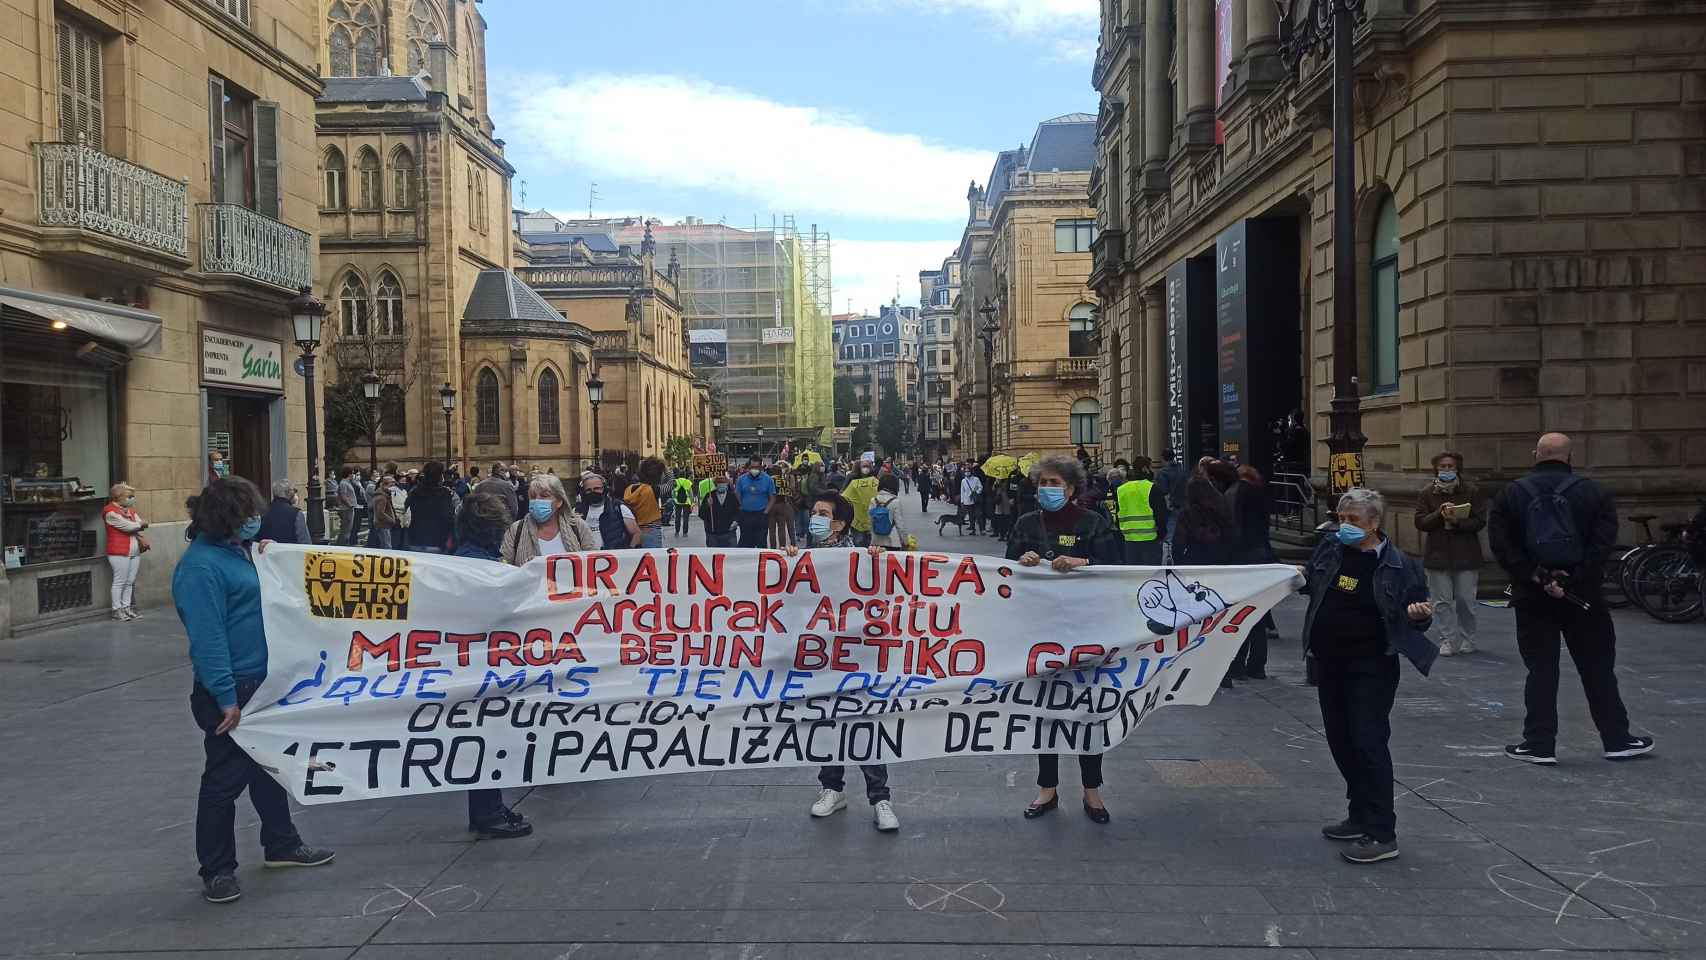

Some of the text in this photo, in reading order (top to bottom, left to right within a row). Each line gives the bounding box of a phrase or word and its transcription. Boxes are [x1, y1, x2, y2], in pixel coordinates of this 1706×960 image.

[351, 553, 409, 584] STOP
[757, 550, 822, 595] DA
[311, 580, 410, 608] METRO
[352, 602, 399, 623] ARI
[573, 594, 963, 638] Ardurak Argitu
[346, 628, 586, 673] METROA
[619, 633, 765, 670] BEHIN
[793, 633, 986, 680] BETIKO
[474, 666, 600, 701] MAS
[638, 666, 813, 701] TIENE
[283, 735, 507, 796] ETRO:
[521, 717, 904, 784] ¡PARALIZACION
